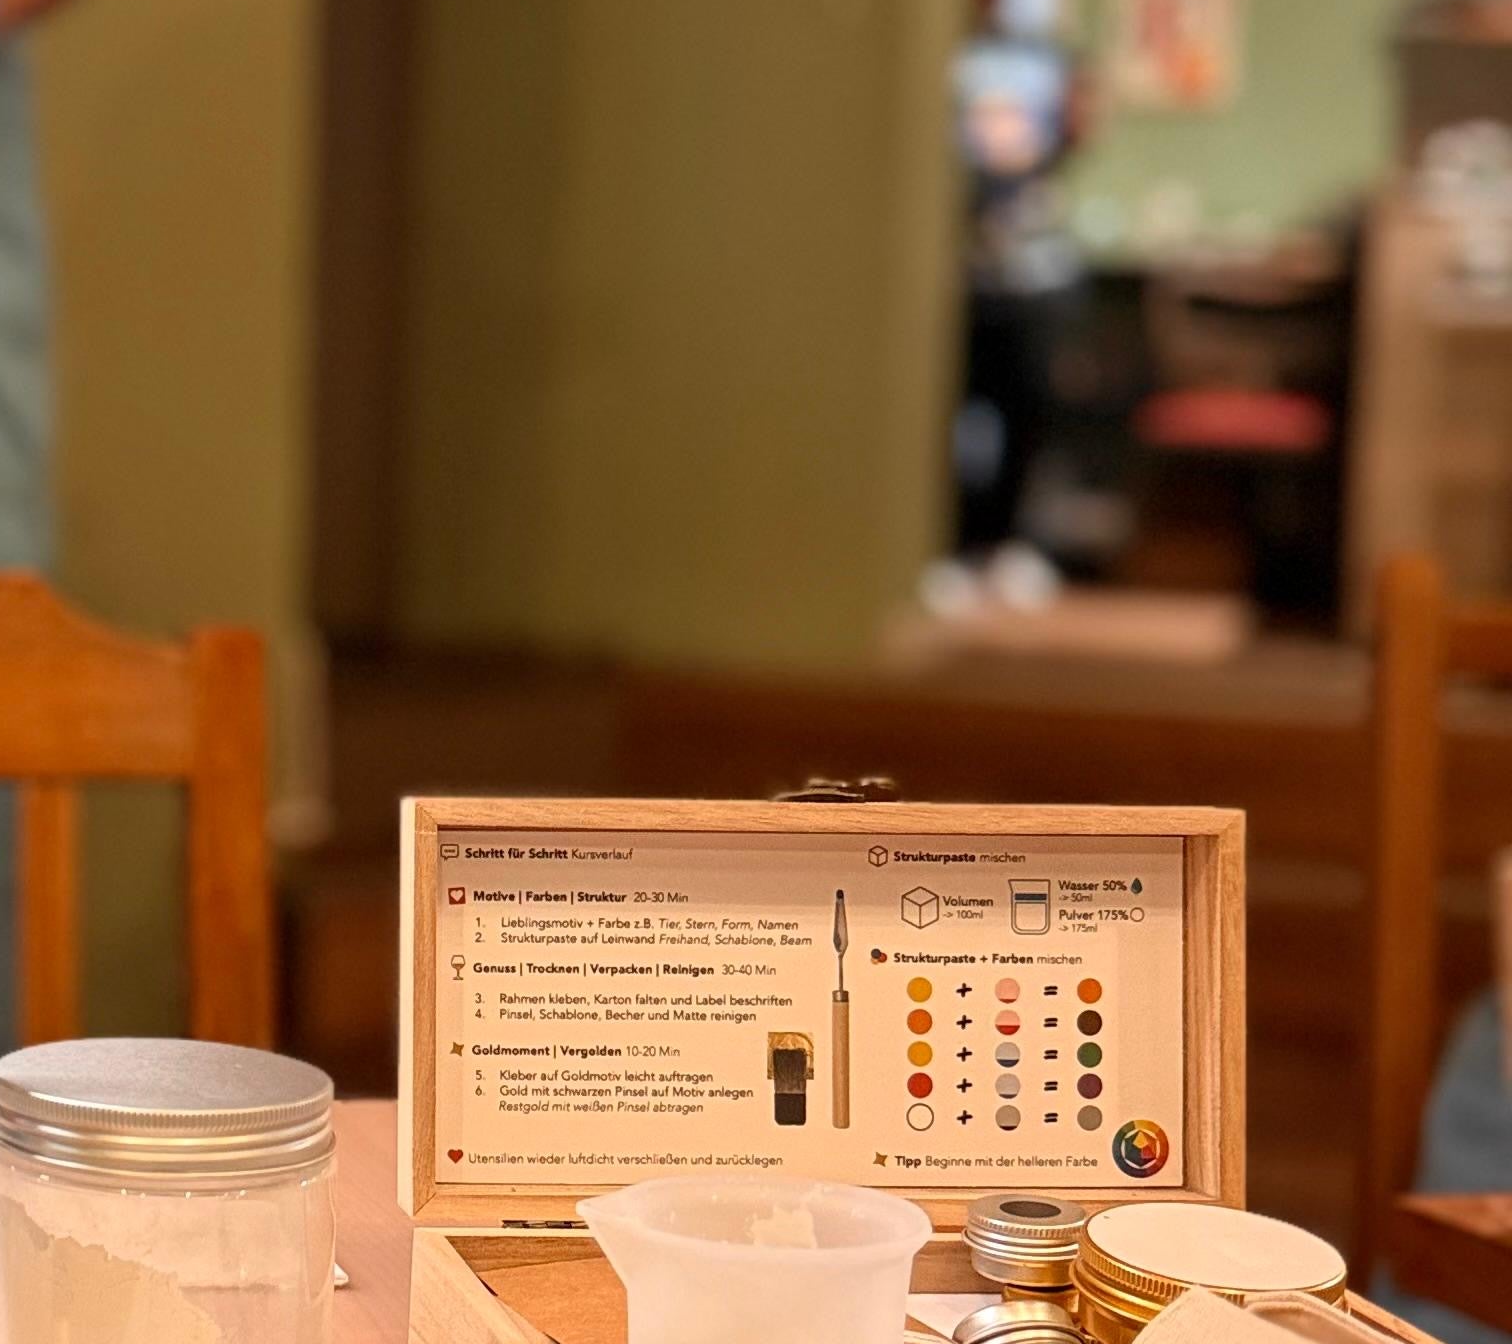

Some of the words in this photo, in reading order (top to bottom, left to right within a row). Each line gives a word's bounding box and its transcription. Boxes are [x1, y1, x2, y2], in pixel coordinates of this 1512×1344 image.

[464, 847, 504, 860] Schritt
[507, 847, 526, 860] für
[529, 847, 569, 860] Schritt
[571, 847, 634, 861] Kursverlauf
[893, 851, 976, 864] Strukturpaste
[979, 852, 1026, 864] mischen
[1058, 880, 1099, 891] Wasser
[1102, 880, 1127, 891] 50%
[473, 891, 516, 903] Motive
[525, 891, 567, 903] Farben
[577, 891, 627, 903] Struktur
[633, 892, 665, 903] 20-30
[667, 892, 689, 904] Min
[942, 896, 994, 907] Volumen
[1071, 892, 1093, 903] 50ml
[956, 909, 984, 920] 100ml
[1058, 909, 1094, 921] Pulver
[1097, 909, 1129, 921] 175%
[501, 917, 583, 931] Lieblingsmotiv
[598, 917, 631, 929] Farbe
[634, 918, 655, 930] z.B.
[658, 918, 682, 931] Tier,
[685, 918, 718, 932] Stern,
[721, 918, 753, 932] Form,
[757, 919, 799, 931] Namen
[1071, 923, 1098, 933] 175ml
[501, 933, 578, 947] Strukturpaste
[580, 933, 598, 945] auf
[601, 933, 655, 945] Leinwand
[658, 933, 711, 946] Freihand,
[714, 934, 777, 947] Schablone,
[780, 934, 813, 946] Beam
[893, 953, 977, 966] Strukturpaste
[992, 953, 1034, 965] Farben
[1036, 954, 1082, 965] mischen
[473, 963, 517, 975] Genuss
[526, 963, 580, 975] Trocknen
[590, 963, 653, 977] Verpacken
[663, 963, 714, 977] Reinigen
[721, 964, 752, 976] 30-40
[754, 965, 776, 976] Min
[499, 994, 546, 1006] Rahmen
[549, 994, 591, 1007] kleben,
[593, 994, 632, 1006] Karton
[635, 994, 667, 1006] falten
[670, 994, 693, 1006] und
[696, 994, 726, 1006] Label
[729, 994, 792, 1007] beschriften
[499, 1009, 536, 1022] Pinsel,
[539, 1009, 602, 1023] Schablone,
[605, 1009, 645, 1021] Becher
[648, 1010, 670, 1022] und
[673, 1010, 707, 1022] Matte
[710, 1010, 757, 1024] reinigen
[472, 1045, 550, 1057] Goldmoment
[560, 1045, 622, 1059] Vergolden
[626, 1046, 657, 1057] 10-20
[659, 1046, 680, 1057] Min
[499, 1070, 538, 1082] Kleber
[541, 1070, 558, 1082] auf
[561, 1070, 622, 1082] Goldmotiv
[624, 1070, 656, 1083] leicht
[658, 1070, 714, 1085] auftragen
[499, 1085, 528, 1097] Gold
[531, 1085, 550, 1097] mit
[552, 1086, 612, 1098] schwarzen
[615, 1086, 649, 1098] Pinsel
[651, 1086, 670, 1098] auf
[673, 1086, 705, 1098] Motiv
[708, 1086, 754, 1100] anlegen
[498, 1101, 549, 1115] Restgold
[552, 1101, 571, 1113] mit
[573, 1101, 614, 1113] weißen
[617, 1101, 650, 1113] Pinsel
[653, 1101, 704, 1115] abtragen
[468, 1153, 524, 1166] Utensilien
[527, 1153, 566, 1166] wieder
[568, 1153, 614, 1166] luftdicht
[617, 1153, 688, 1167] verschließen
[690, 1154, 713, 1166] und
[716, 1154, 784, 1169] zurücklegen
[894, 1156, 922, 1169] Tipp
[925, 1156, 972, 1170] Beginne
[975, 1156, 993, 1168] mit
[996, 1156, 1015, 1168] der
[1018, 1156, 1063, 1168] helleren
[1066, 1156, 1098, 1168] Farbe
